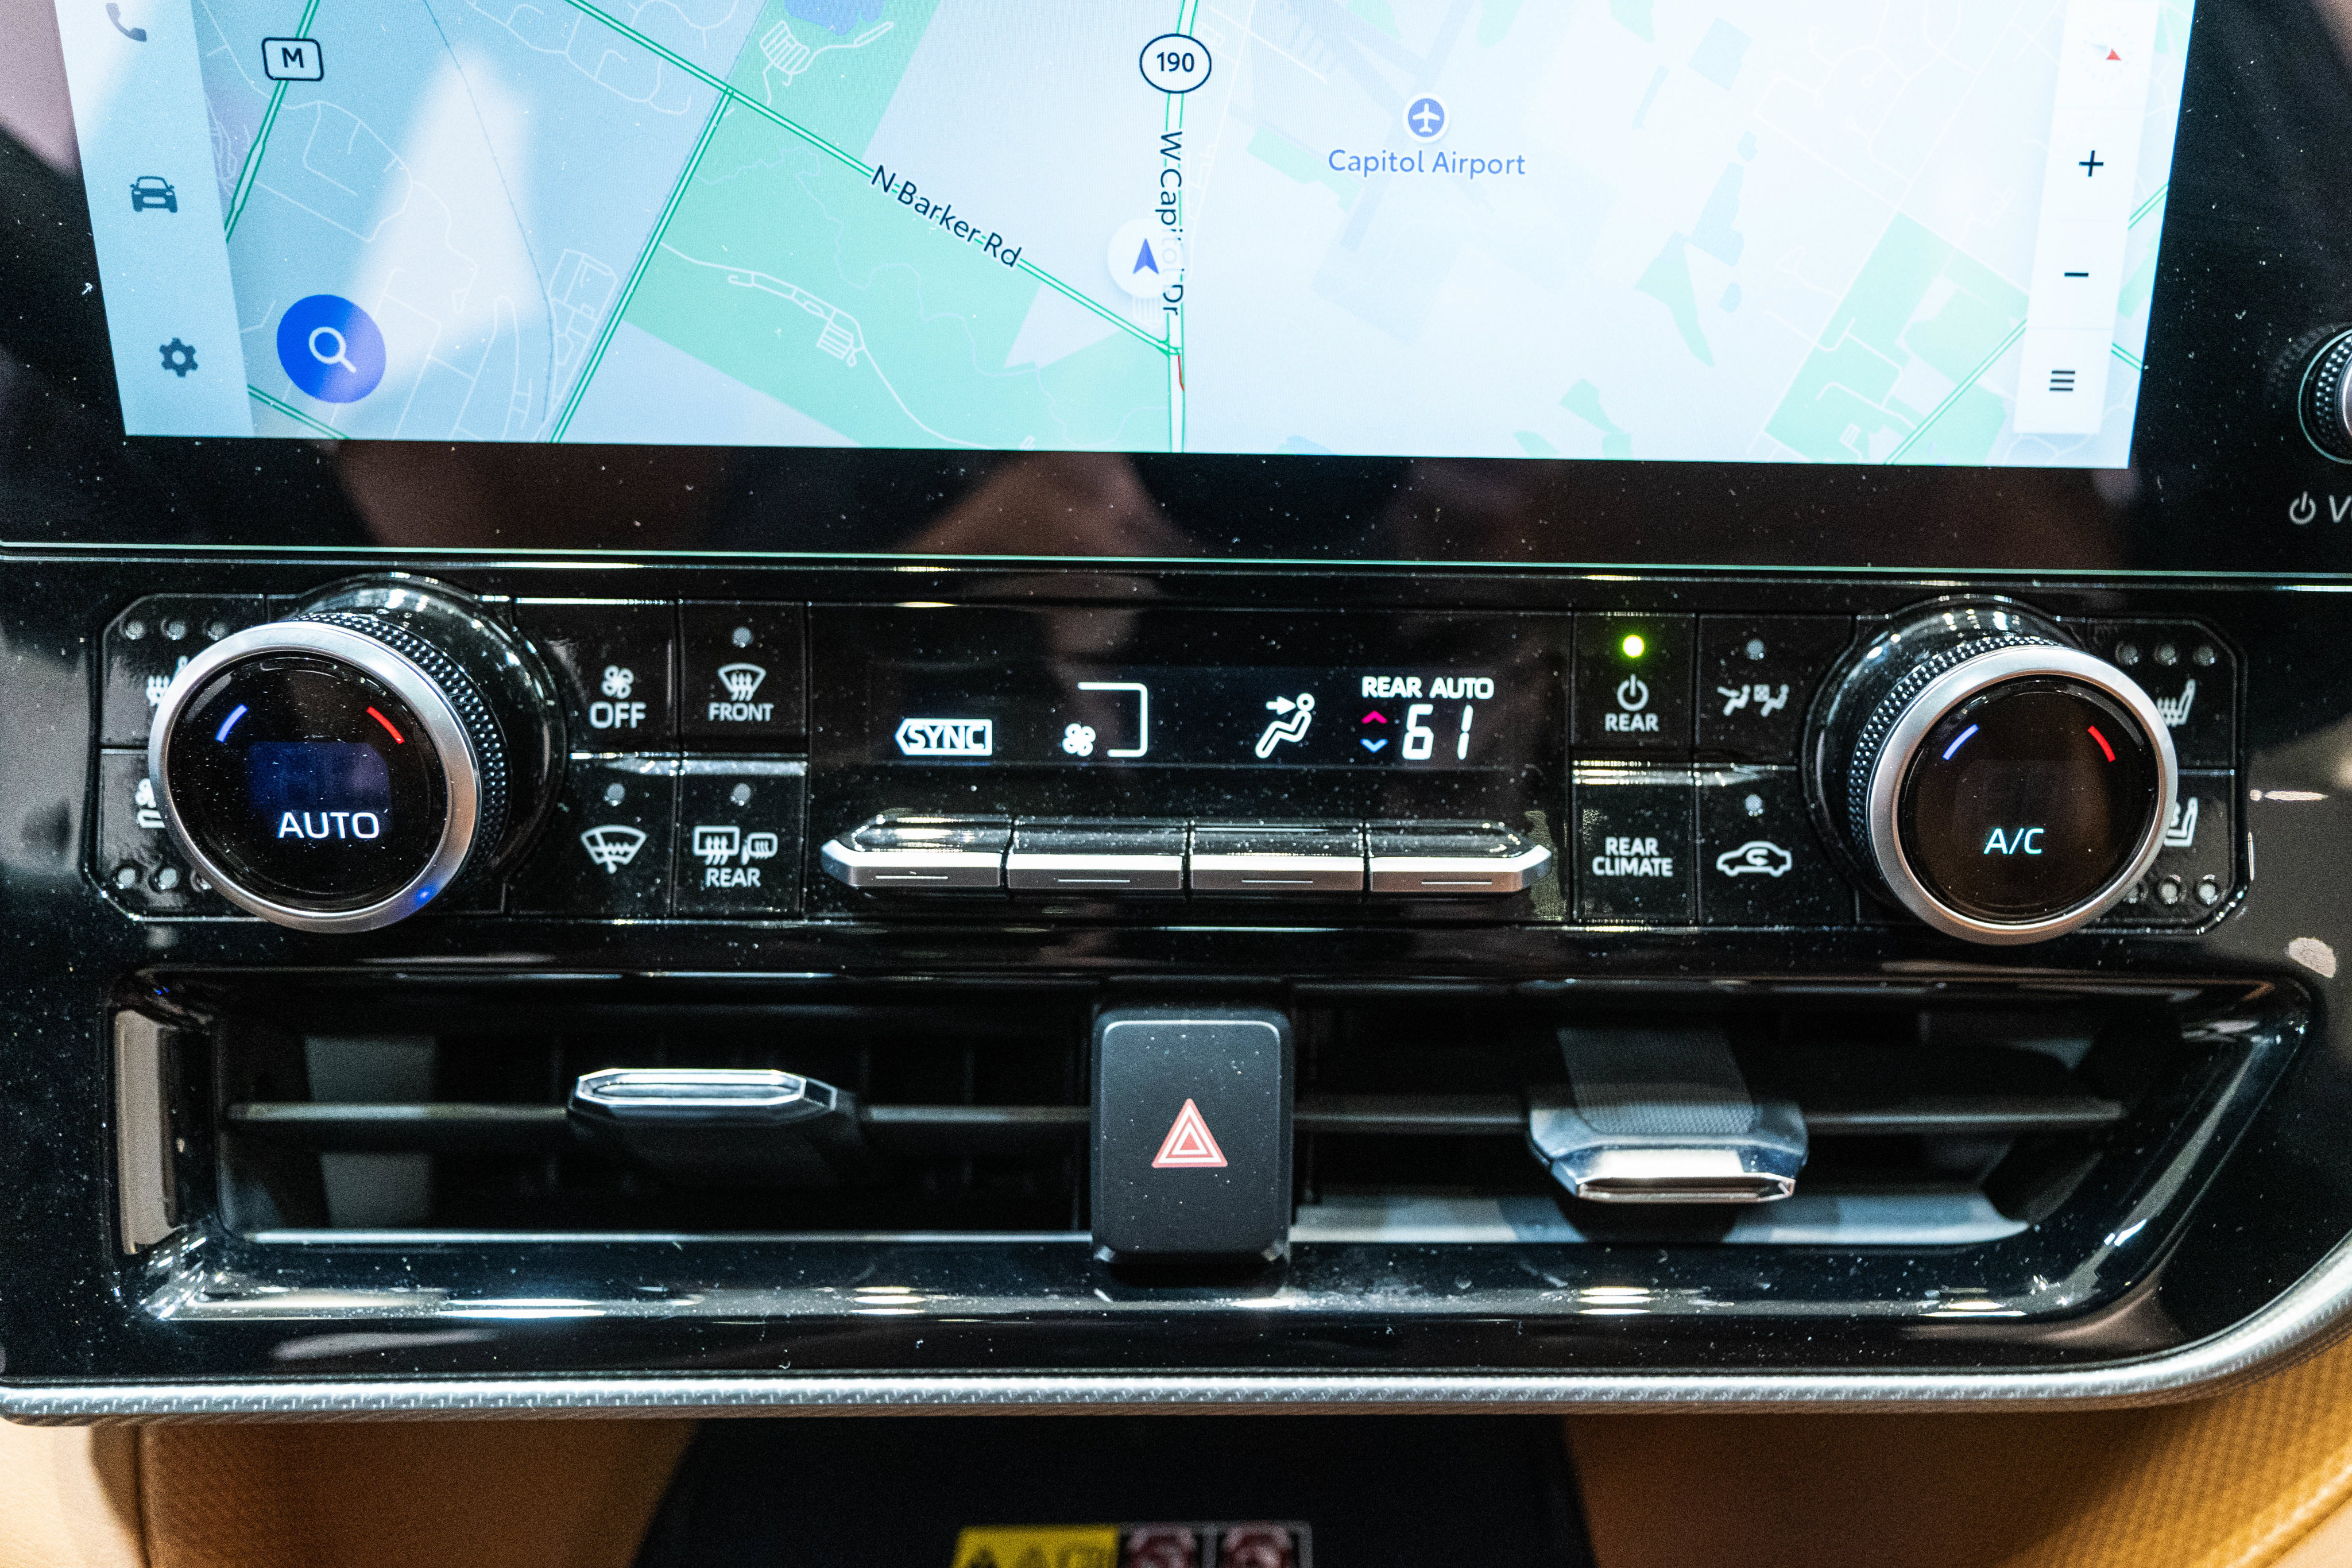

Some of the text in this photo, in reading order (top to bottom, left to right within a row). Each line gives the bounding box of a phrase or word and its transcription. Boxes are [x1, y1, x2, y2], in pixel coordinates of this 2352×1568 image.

[281, 47, 305, 68] M
[1156, 52, 1195, 73] 190
[1160, 131, 1183, 161] W
[1329, 149, 1525, 180] Capitol Airport
[871, 164, 1022, 267] N Barker Rd
[2328, 494, 2352, 523] V
[1361, 676, 1495, 699] REAR AUTO
[589, 702, 647, 729] OFF
[708, 702, 775, 722] FRONT
[1604, 713, 1659, 732] REAR
[907, 725, 985, 749] SYNC
[1401, 703, 1474, 761] 61
[278, 811, 380, 839] AUTO
[1604, 836, 1659, 857] REAR
[1983, 827, 2045, 855] A/C
[705, 866, 761, 888] REAR
[1592, 855, 1674, 877] CLIMATE
